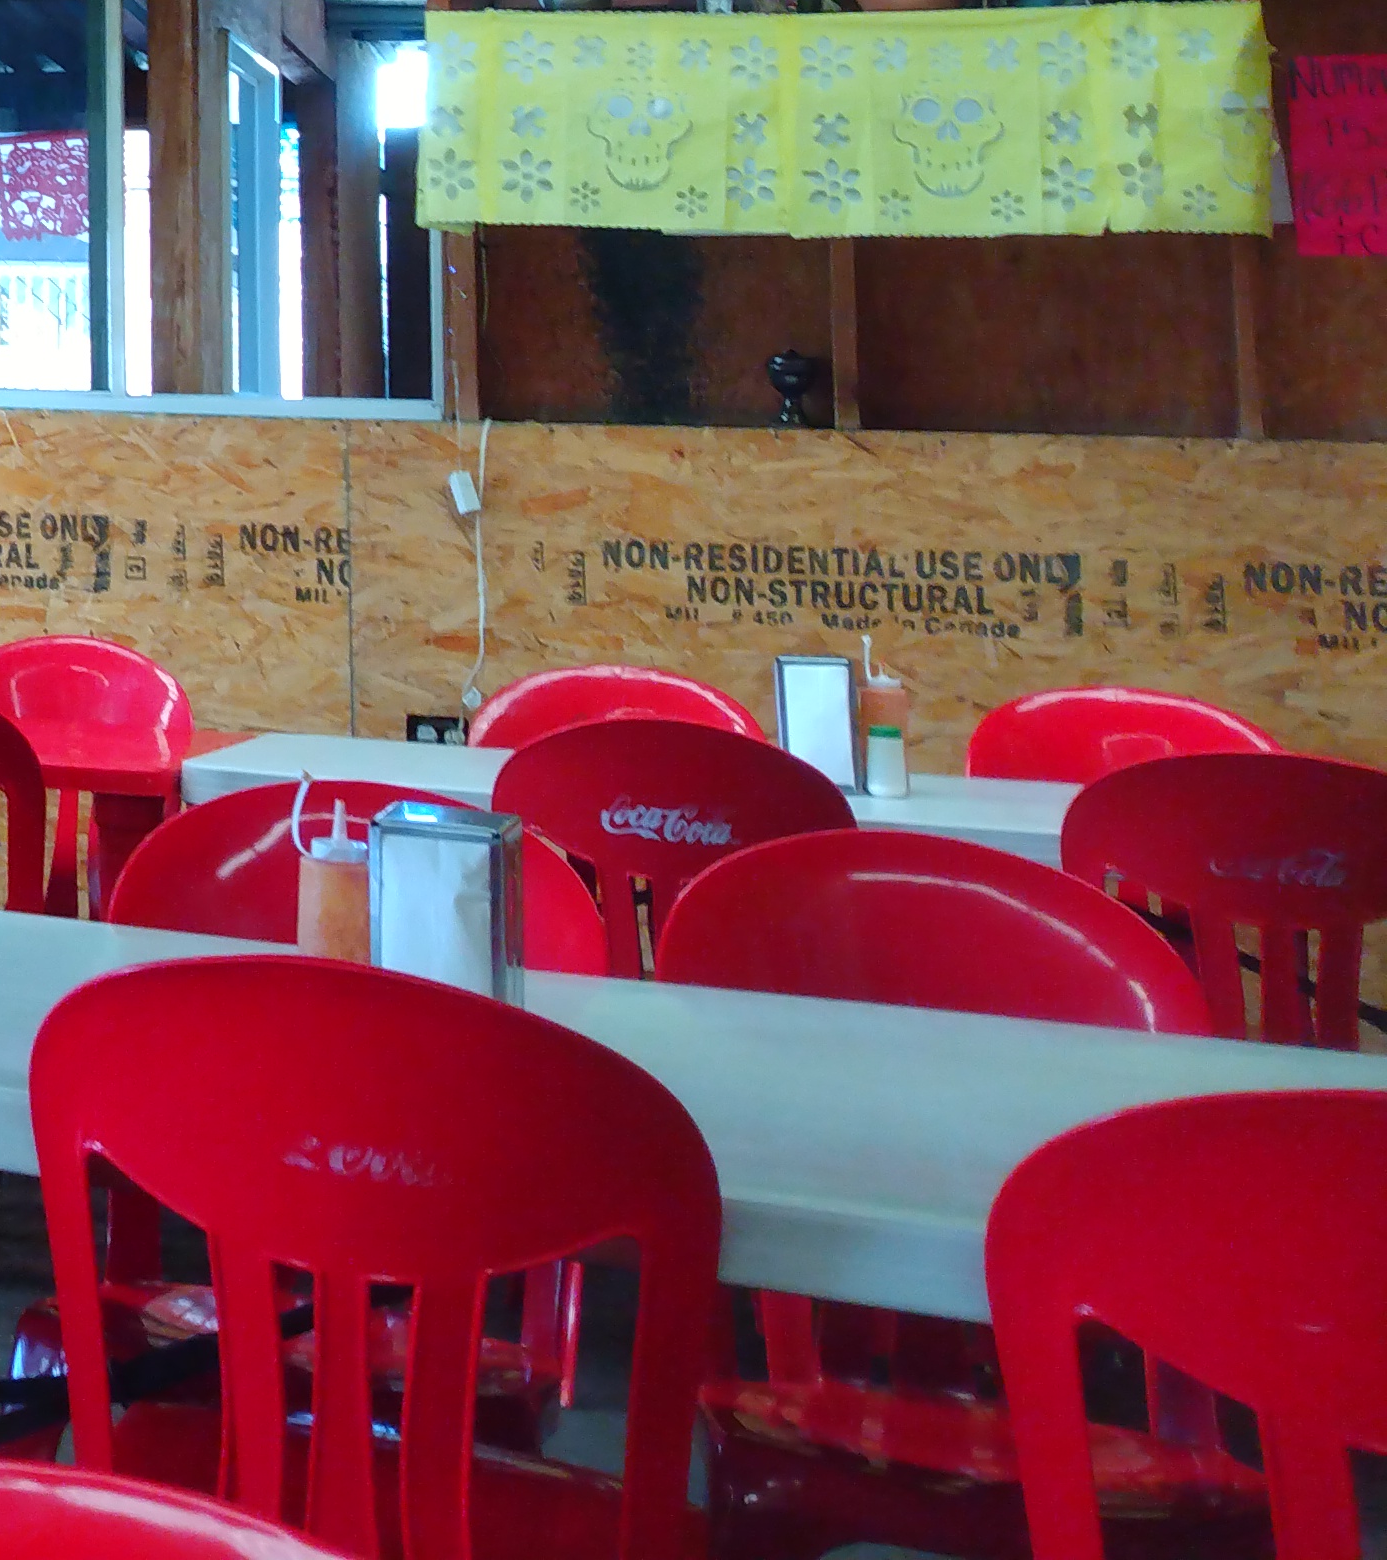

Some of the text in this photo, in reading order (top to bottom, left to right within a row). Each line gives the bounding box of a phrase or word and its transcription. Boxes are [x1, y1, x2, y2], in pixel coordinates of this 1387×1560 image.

[602, 539, 906, 578] NON-RESIDENTIAL
[915, 549, 984, 582] USE
[686, 575, 994, 616] NON-STRUCTURAL
